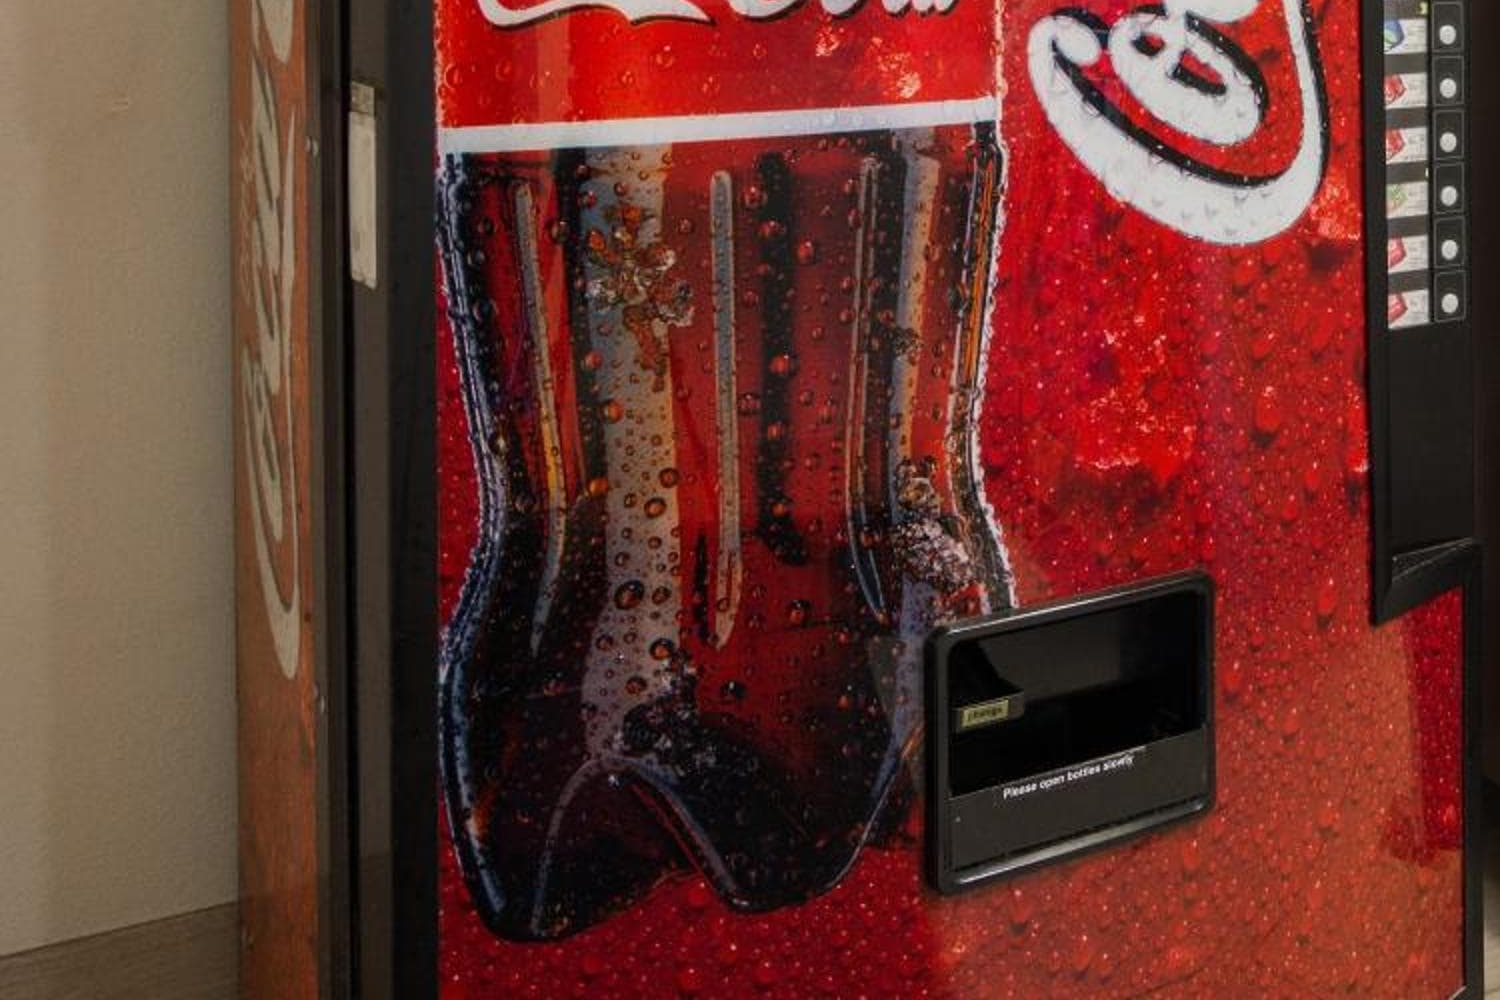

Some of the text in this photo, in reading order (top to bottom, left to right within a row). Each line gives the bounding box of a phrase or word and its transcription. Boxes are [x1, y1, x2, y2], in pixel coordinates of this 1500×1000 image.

[1003, 753, 1136, 800] Please open bottles slowly
